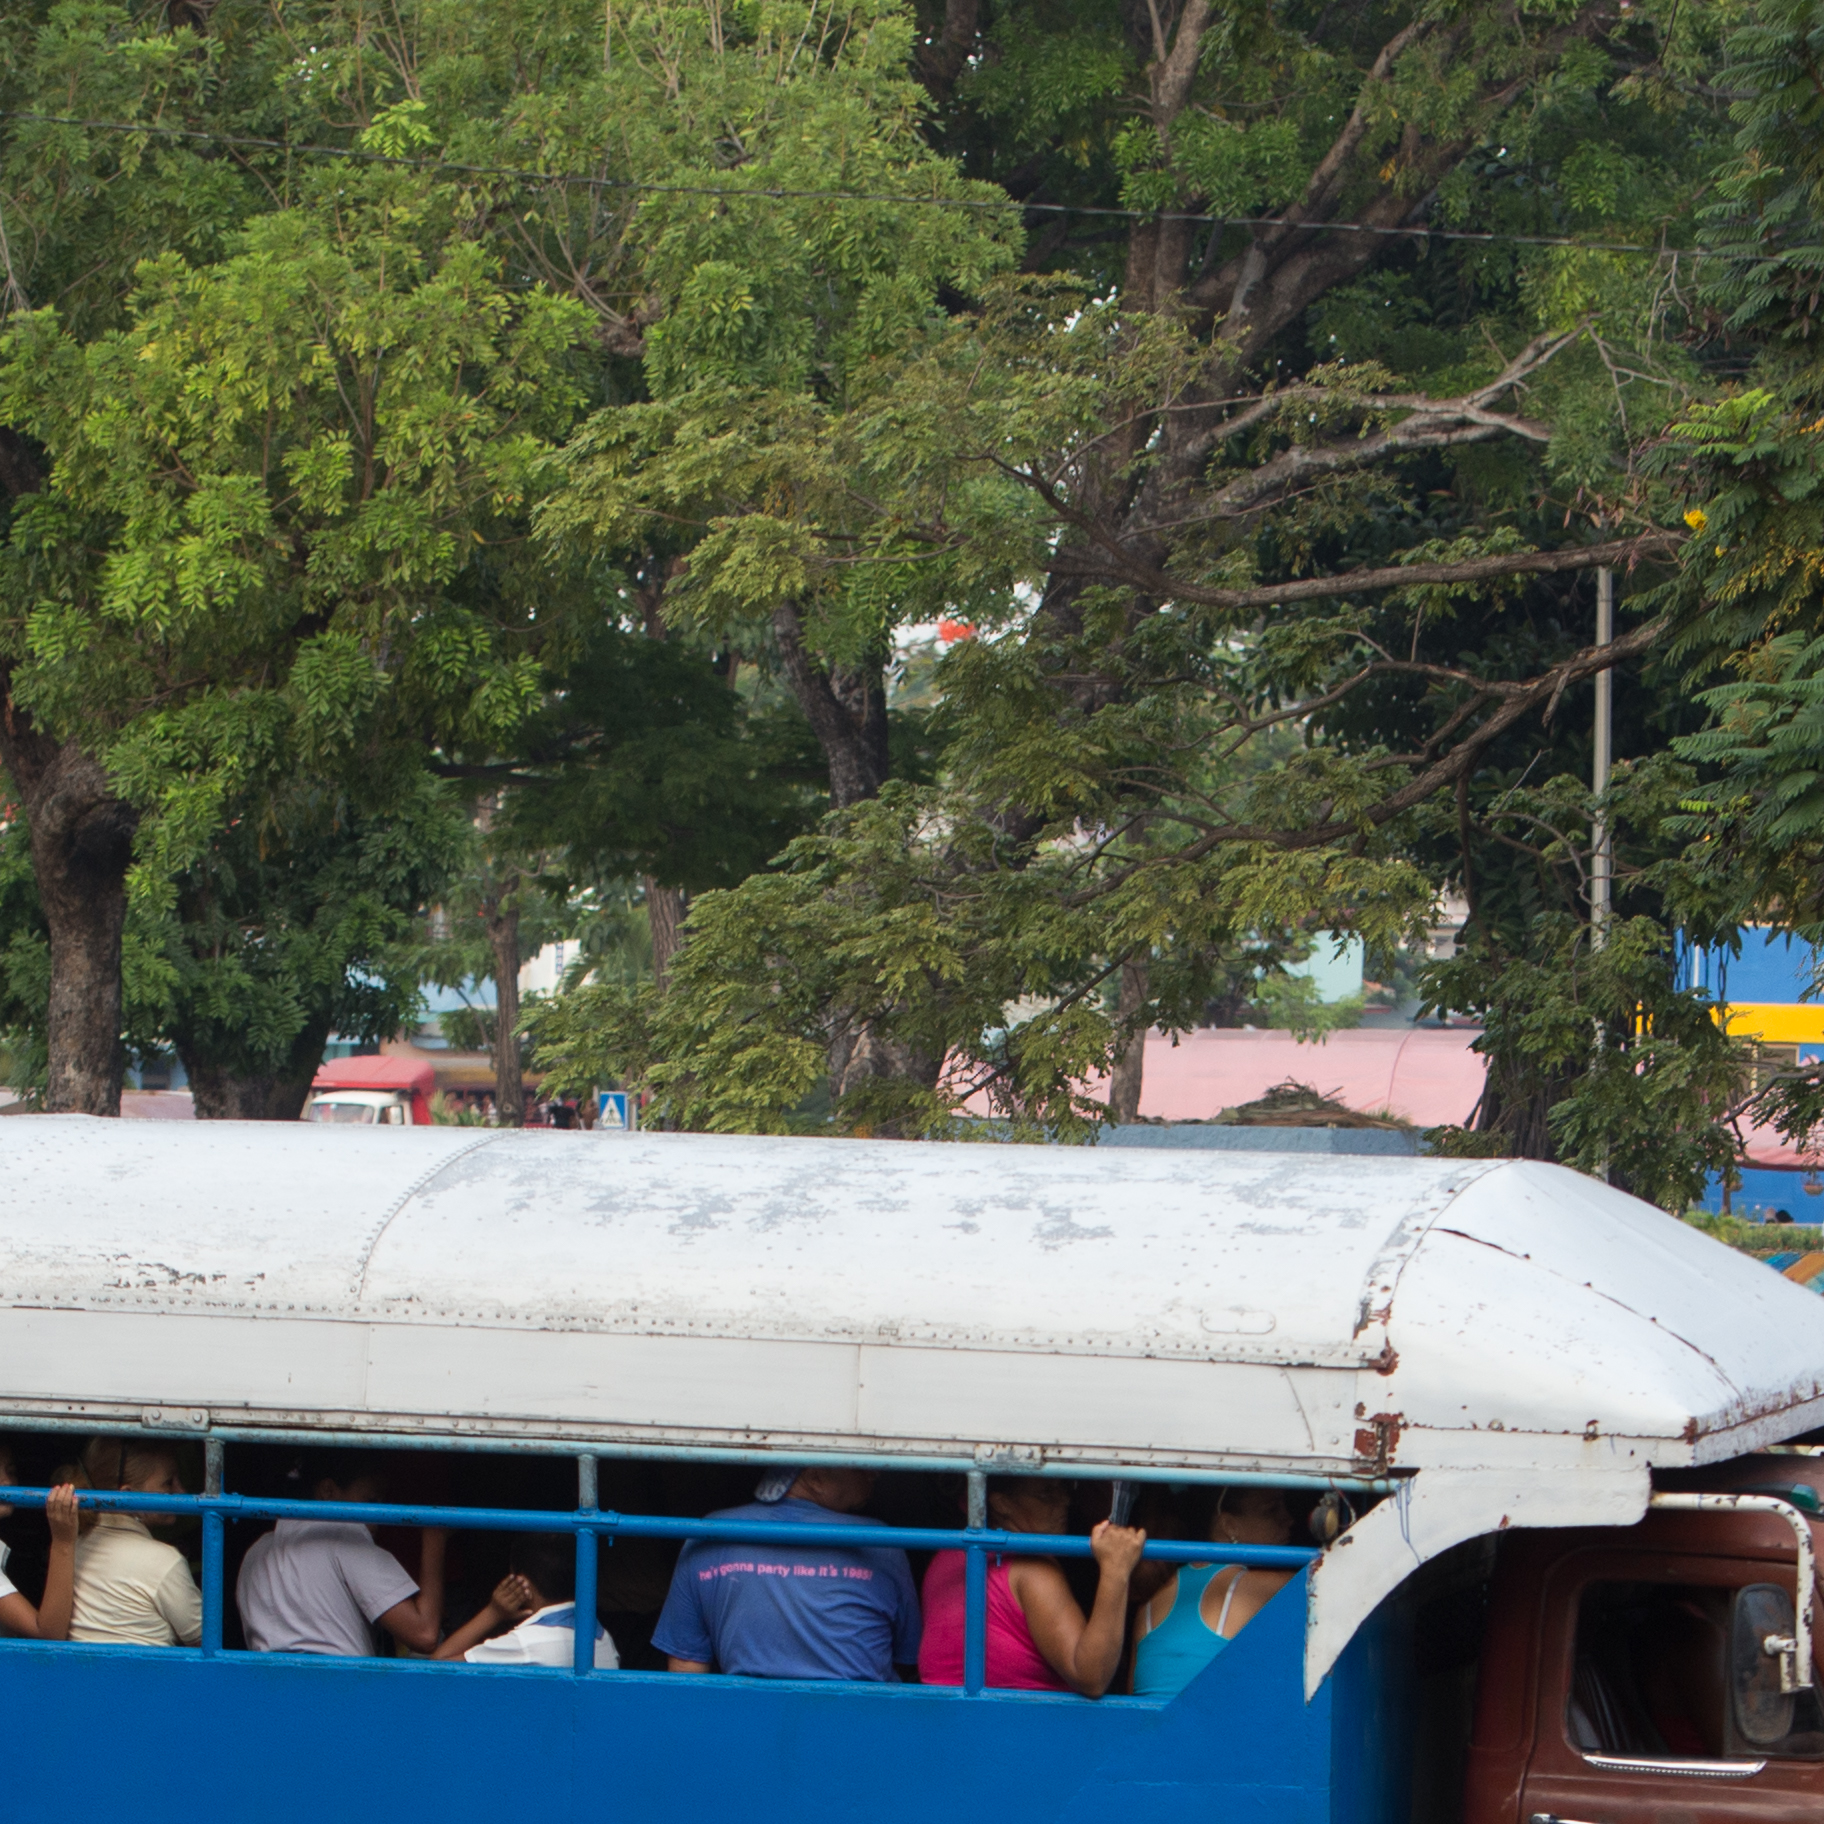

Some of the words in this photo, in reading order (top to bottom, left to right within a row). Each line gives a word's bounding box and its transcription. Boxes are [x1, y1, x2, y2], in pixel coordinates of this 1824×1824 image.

[719, 1562, 754, 1576] gonna
[757, 1563, 790, 1577] party
[793, 1564, 816, 1576] like
[819, 1563, 838, 1577] it's
